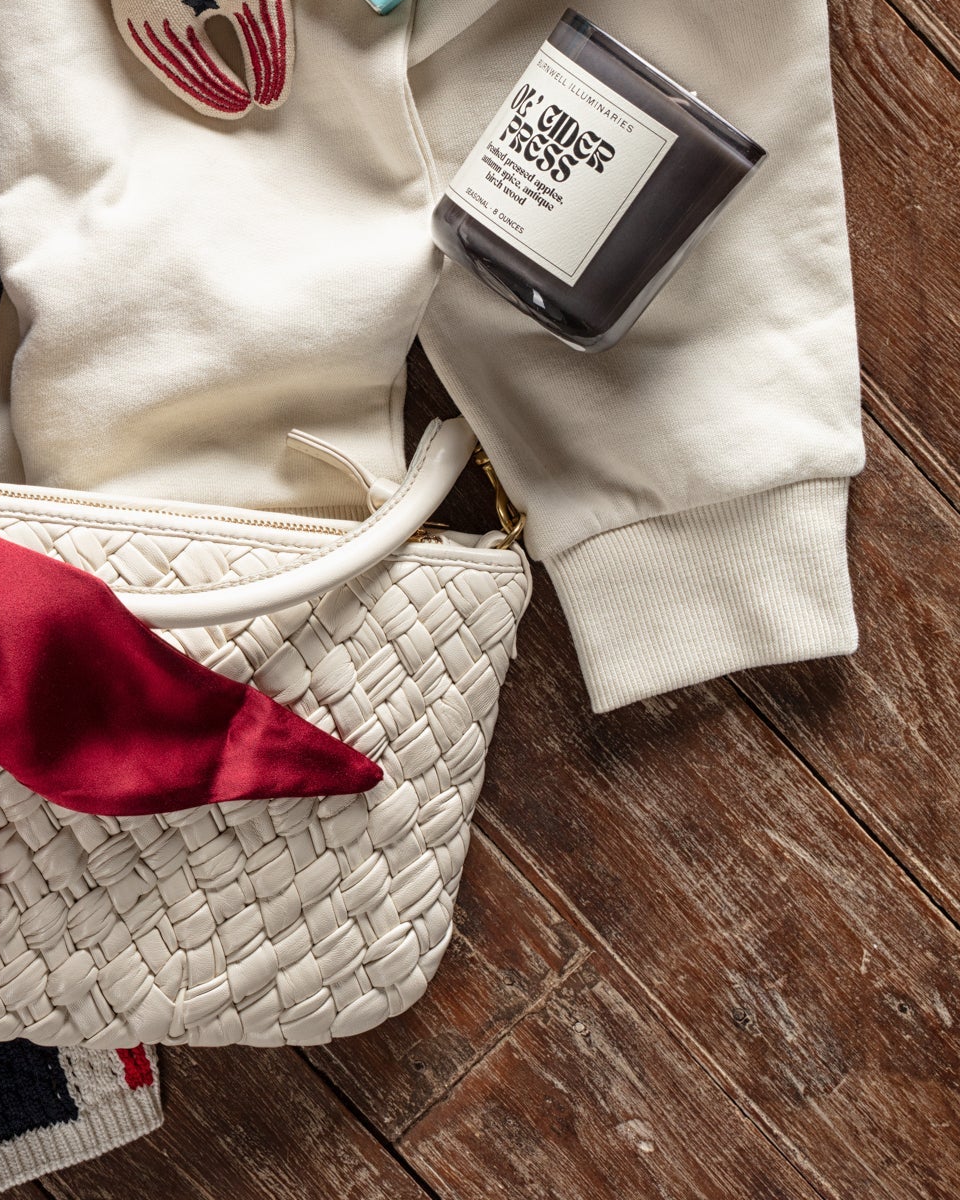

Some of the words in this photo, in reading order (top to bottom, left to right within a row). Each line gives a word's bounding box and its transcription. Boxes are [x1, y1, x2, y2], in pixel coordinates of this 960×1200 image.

[568, 83, 634, 133] ILLUMINARIES
[499, 114, 580, 182] PRESS
[537, 104, 616, 174] CIDER
[481, 154, 502, 173] autumn
[501, 170, 521, 189] spice,
[522, 186, 554, 211] antique
[485, 171, 503, 189] birch
[503, 185, 527, 206] wood
[503, 158, 536, 183] pressed
[534, 180, 564, 205] apples,
[466, 187, 488, 209] SEASONAL
[498, 212, 525, 234] OUNCES
